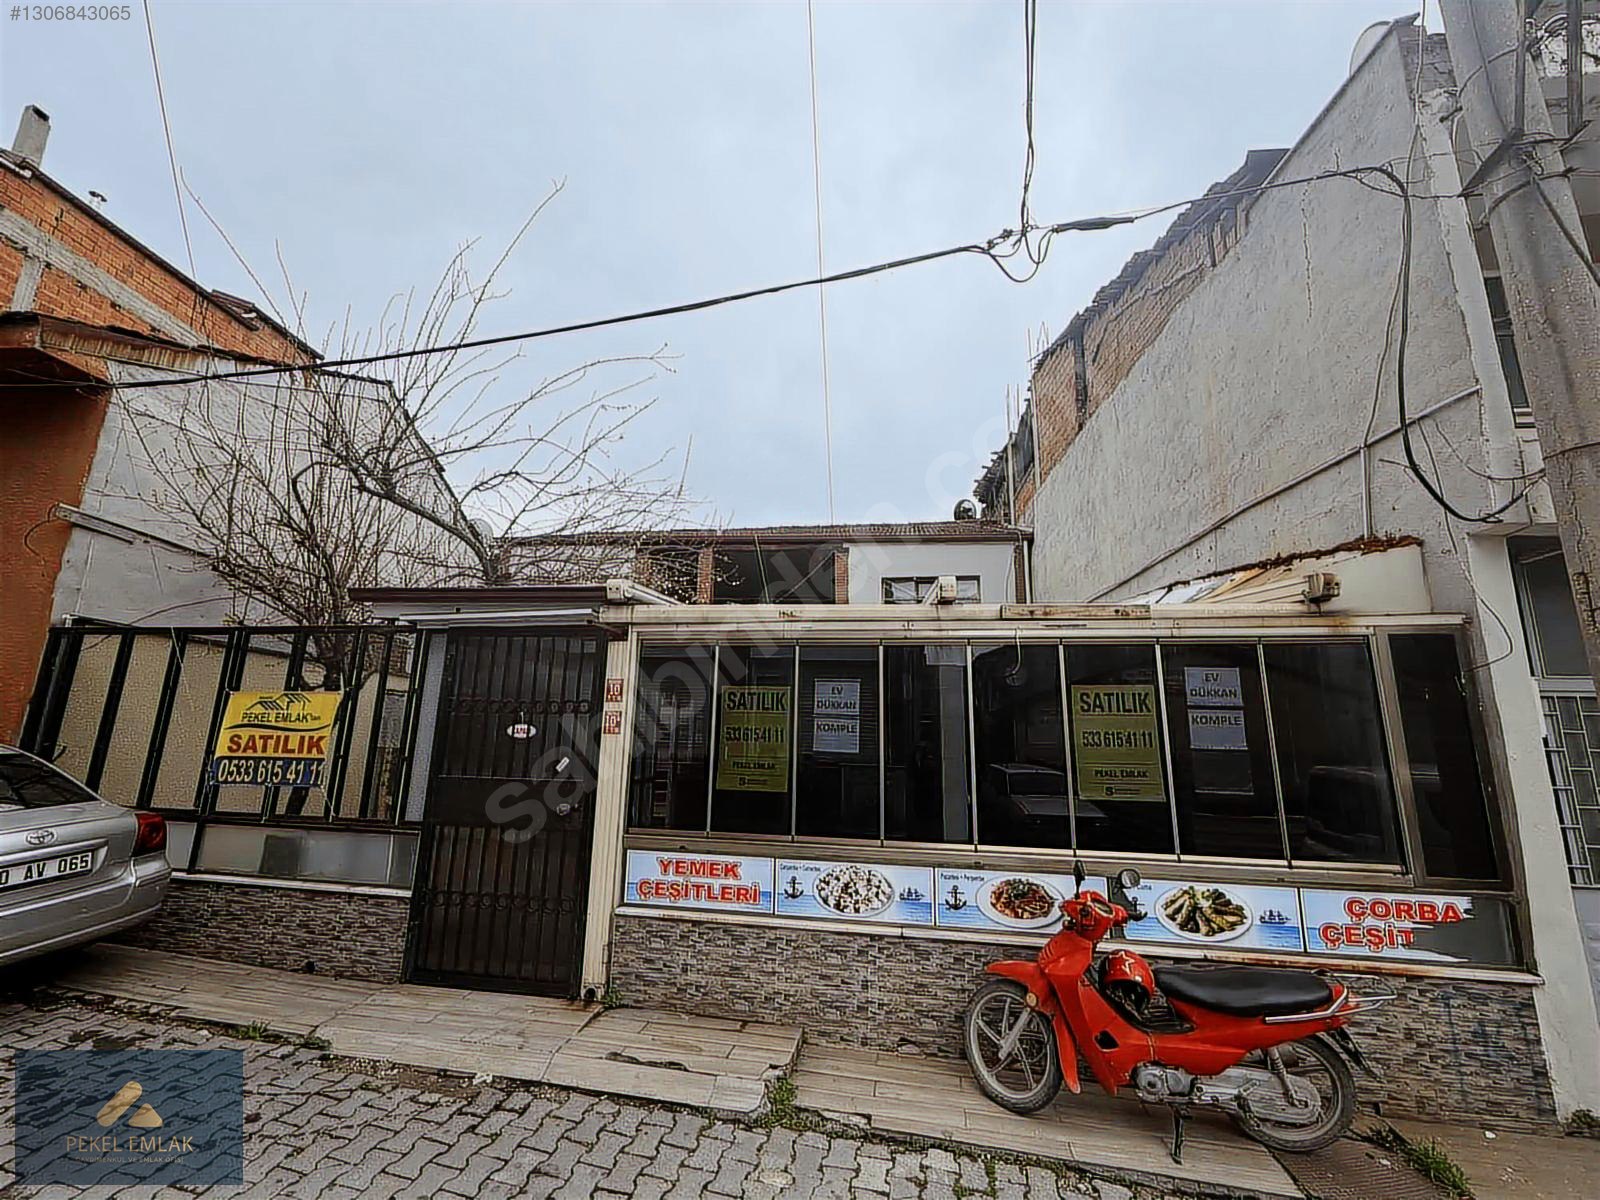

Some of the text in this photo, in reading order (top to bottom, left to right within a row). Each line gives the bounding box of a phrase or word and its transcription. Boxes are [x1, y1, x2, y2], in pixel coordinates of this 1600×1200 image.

[1205, 672, 1219, 682] EV
[831, 686, 844, 695] EV
[726, 691, 786, 712] SATILIK
[1079, 692, 1151, 714] SATILIK
[241, 712, 273, 723] PEKEL
[1192, 714, 1243, 726] KOMPLE
[816, 723, 858, 735] KOMPLE
[227, 733, 327, 756] SATILIK
[218, 759, 327, 785] 0533 615 41 11
[24, 862, 46, 881] AV
[58, 855, 89, 873] 065
[658, 857, 741, 878] YEMEK
[637, 880, 760, 904] ÇEŞİTLERİ
[1346, 897, 1465, 923] ÇORBA
